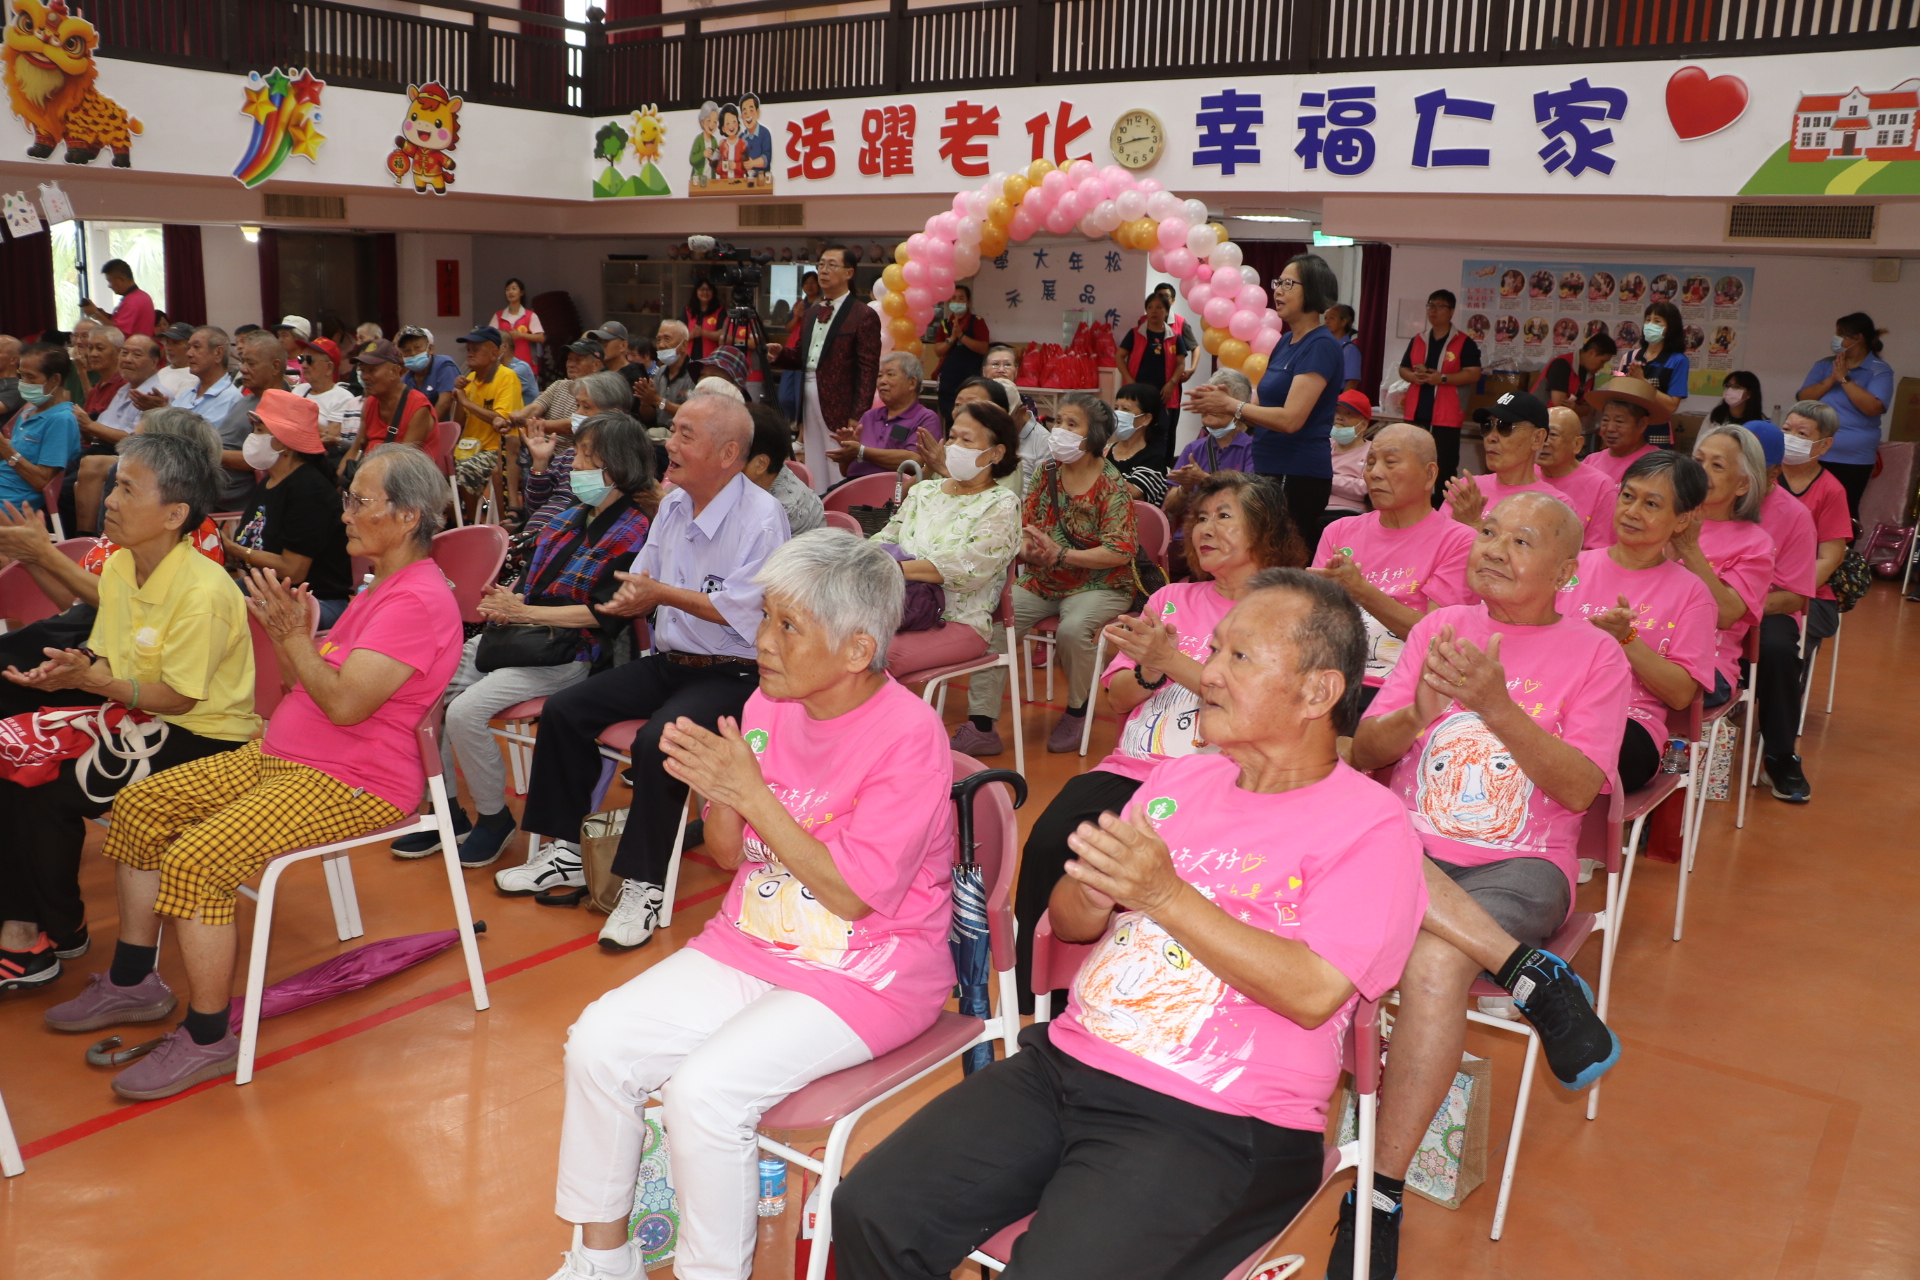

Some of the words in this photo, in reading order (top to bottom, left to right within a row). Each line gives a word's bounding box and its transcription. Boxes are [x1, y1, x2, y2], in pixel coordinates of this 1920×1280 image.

[1135, 115, 1142, 123] 12
[785, 100, 1093, 181] 活躍老化
[1192, 77, 1628, 178] 幸福仁家
[1119, 126, 1127, 134] 10
